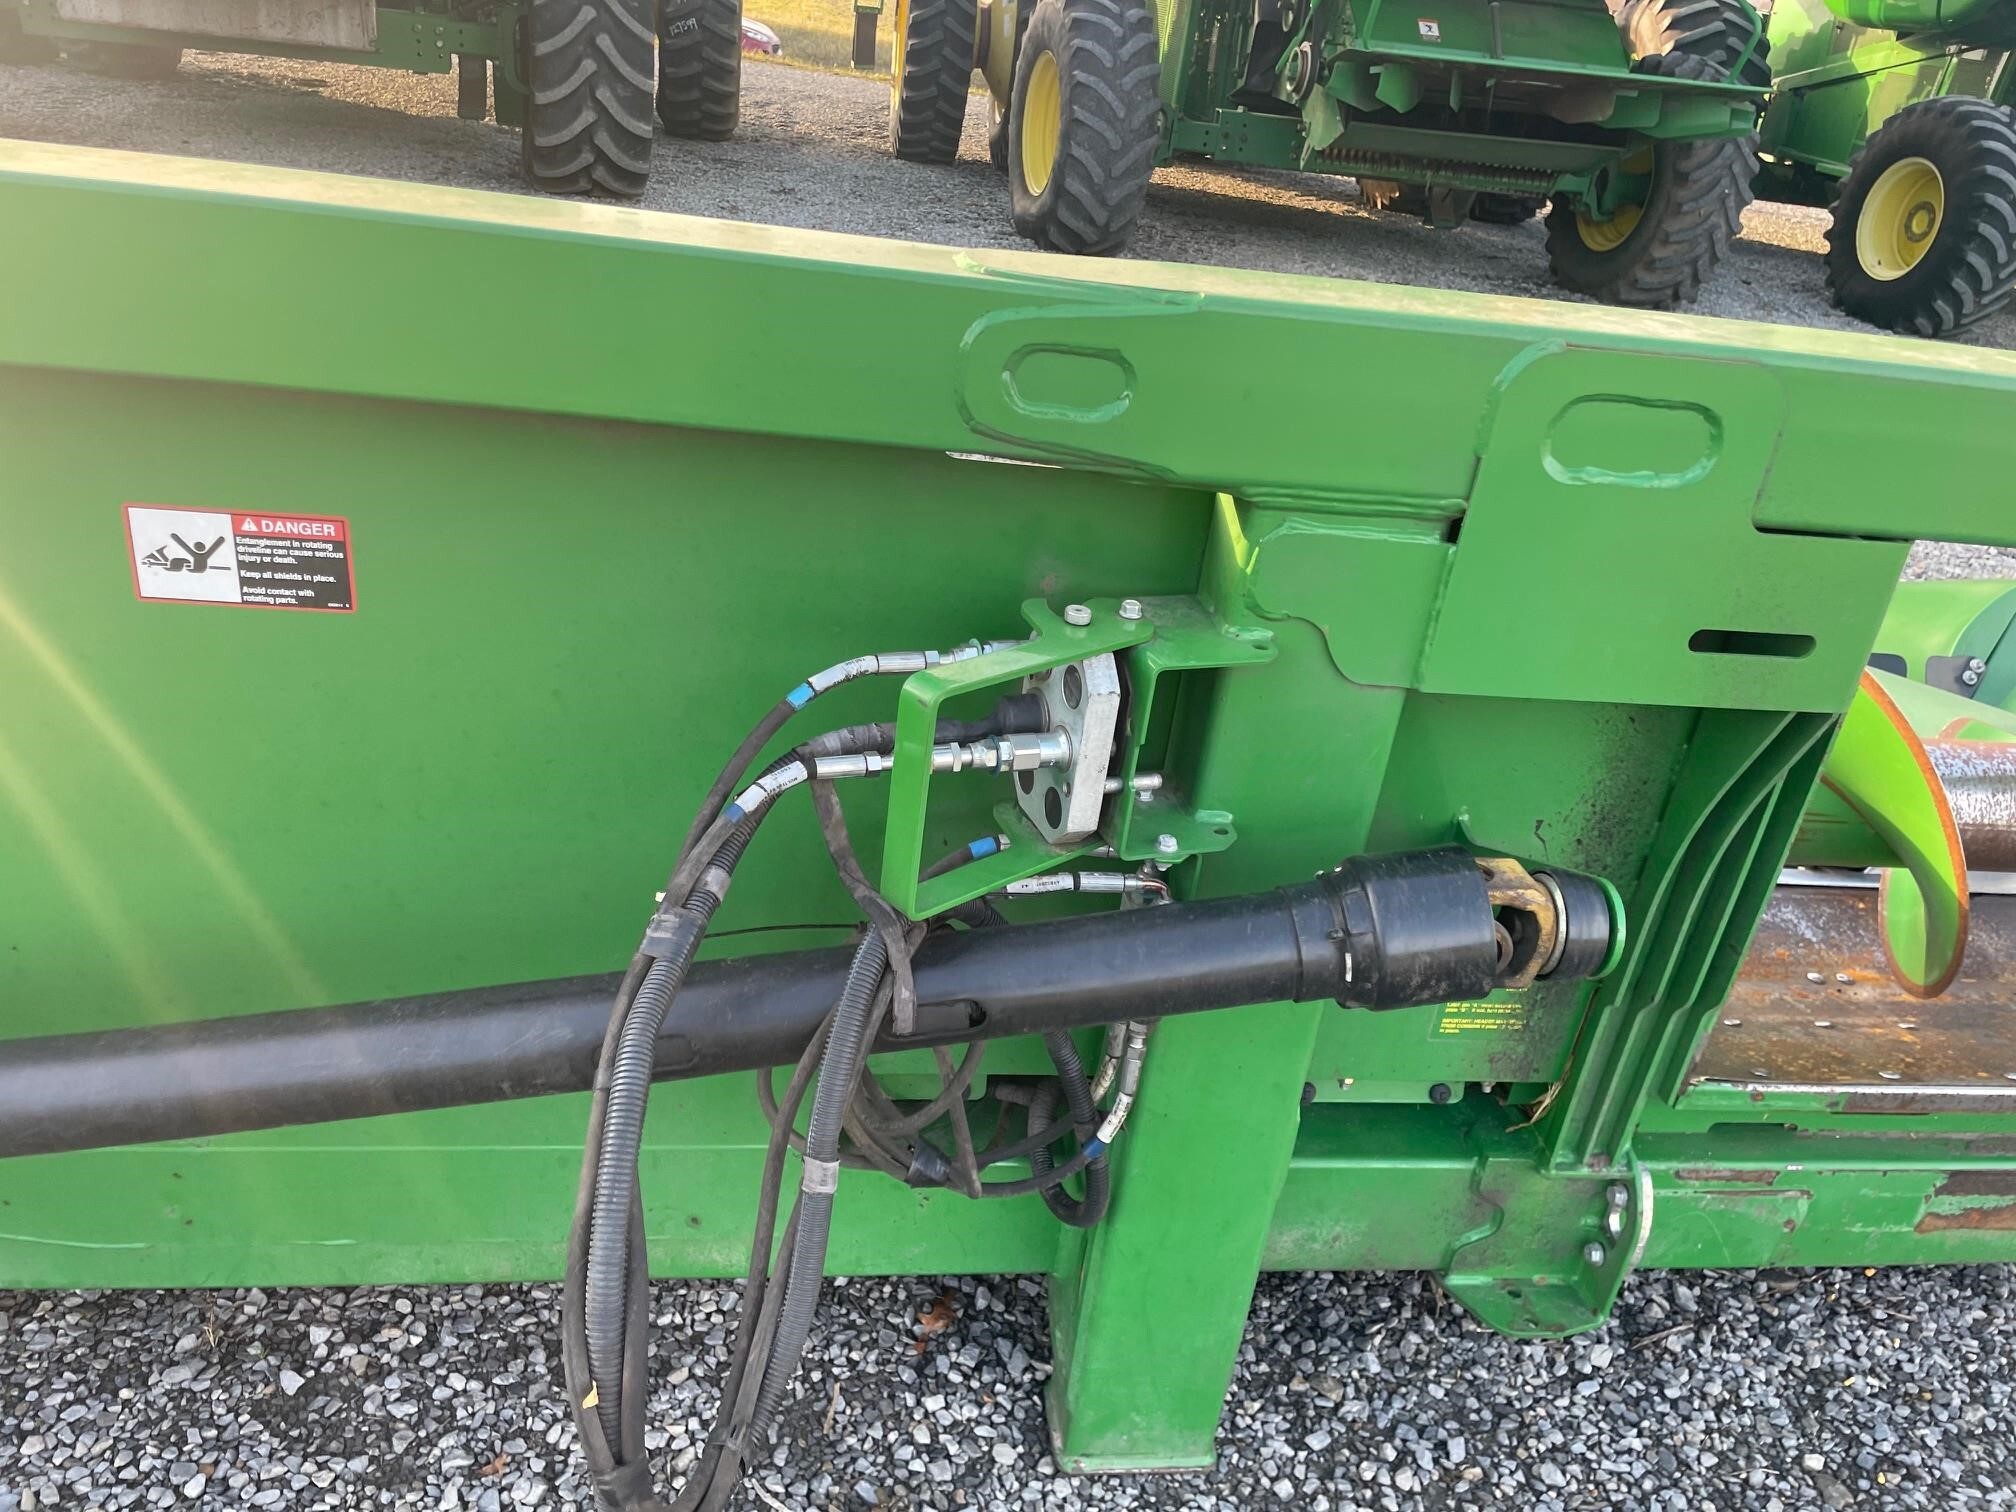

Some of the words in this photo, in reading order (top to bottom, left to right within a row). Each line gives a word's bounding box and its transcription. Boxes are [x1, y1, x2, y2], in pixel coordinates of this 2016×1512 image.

[261, 519, 336, 537] DANGER
[236, 536, 291, 548] Entanglement
[302, 541, 333, 551] rotating
[237, 545, 272, 554] driveline
[289, 549, 313, 557] cause
[314, 550, 344, 558] serious
[238, 554, 261, 563] injury
[273, 556, 298, 564] death.
[240, 569, 261, 579] Keep
[262, 571, 272, 579] all
[274, 572, 302, 581] shields
[313, 574, 337, 583] place.
[242, 586, 266, 595] Avoid
[267, 588, 296, 596] contact
[297, 589, 315, 597] with
[243, 595, 274, 604] rotating
[275, 597, 298, 605] parts.
